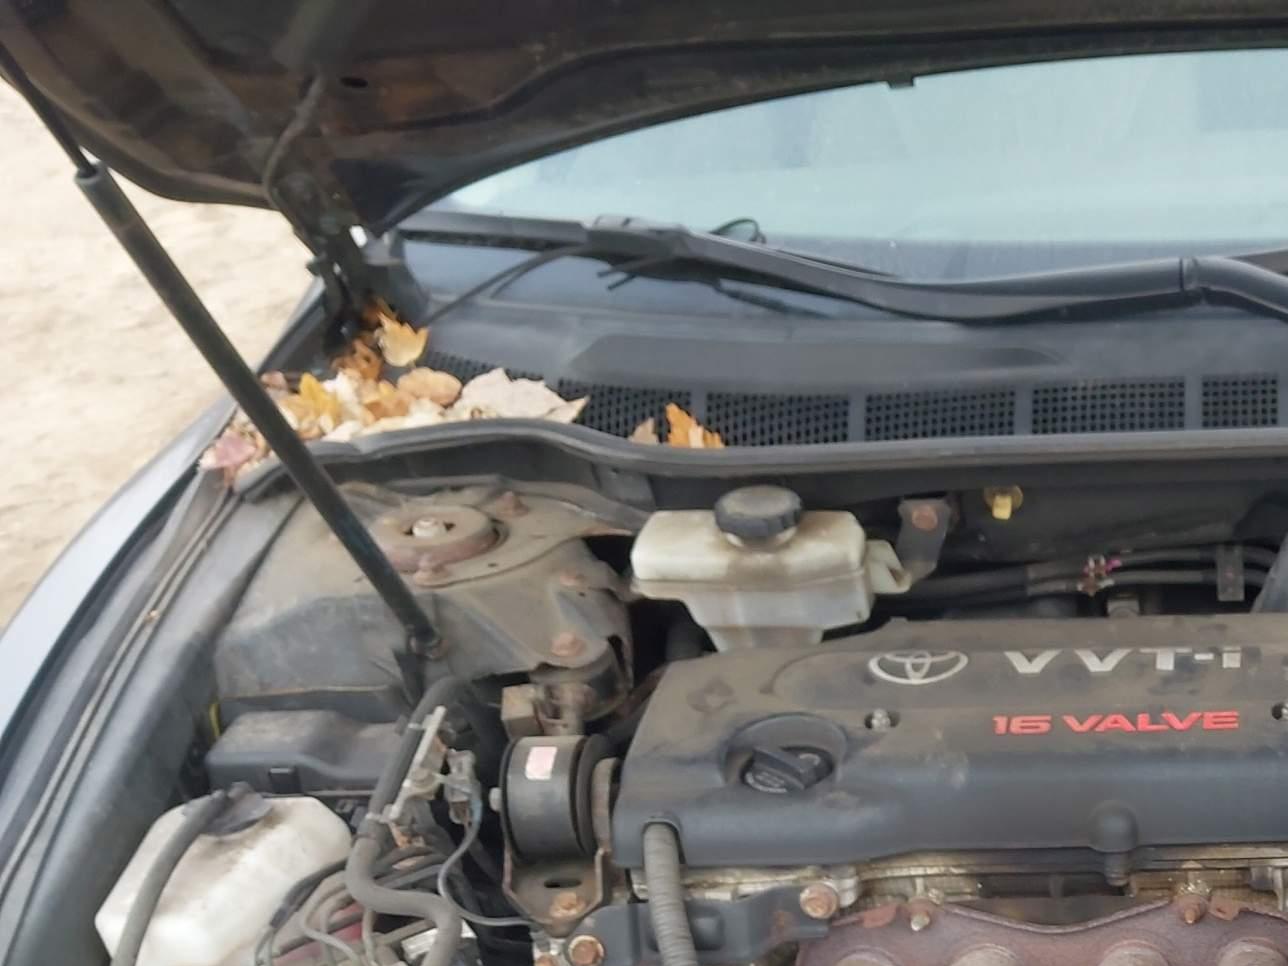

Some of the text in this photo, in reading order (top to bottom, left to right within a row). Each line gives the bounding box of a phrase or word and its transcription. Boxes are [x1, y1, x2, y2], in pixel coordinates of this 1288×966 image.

[1004, 648, 1242, 674] VVT-i
[992, 711, 1240, 735] 16 VALVE
